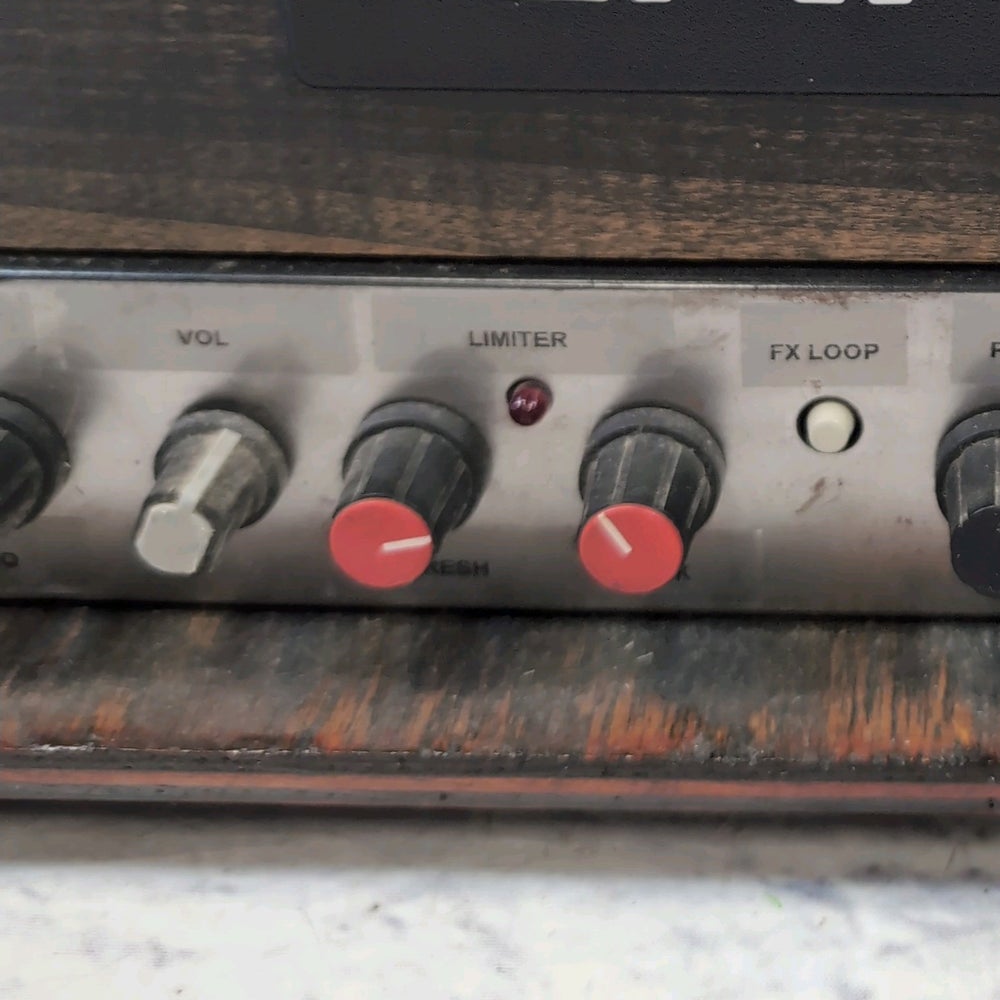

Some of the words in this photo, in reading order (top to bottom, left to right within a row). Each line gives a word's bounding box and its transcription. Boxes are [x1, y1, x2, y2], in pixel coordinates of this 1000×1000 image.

[176, 328, 229, 347] VOL
[468, 330, 568, 348] LIMITER
[769, 343, 801, 361] FX
[808, 343, 881, 361] LOOP
